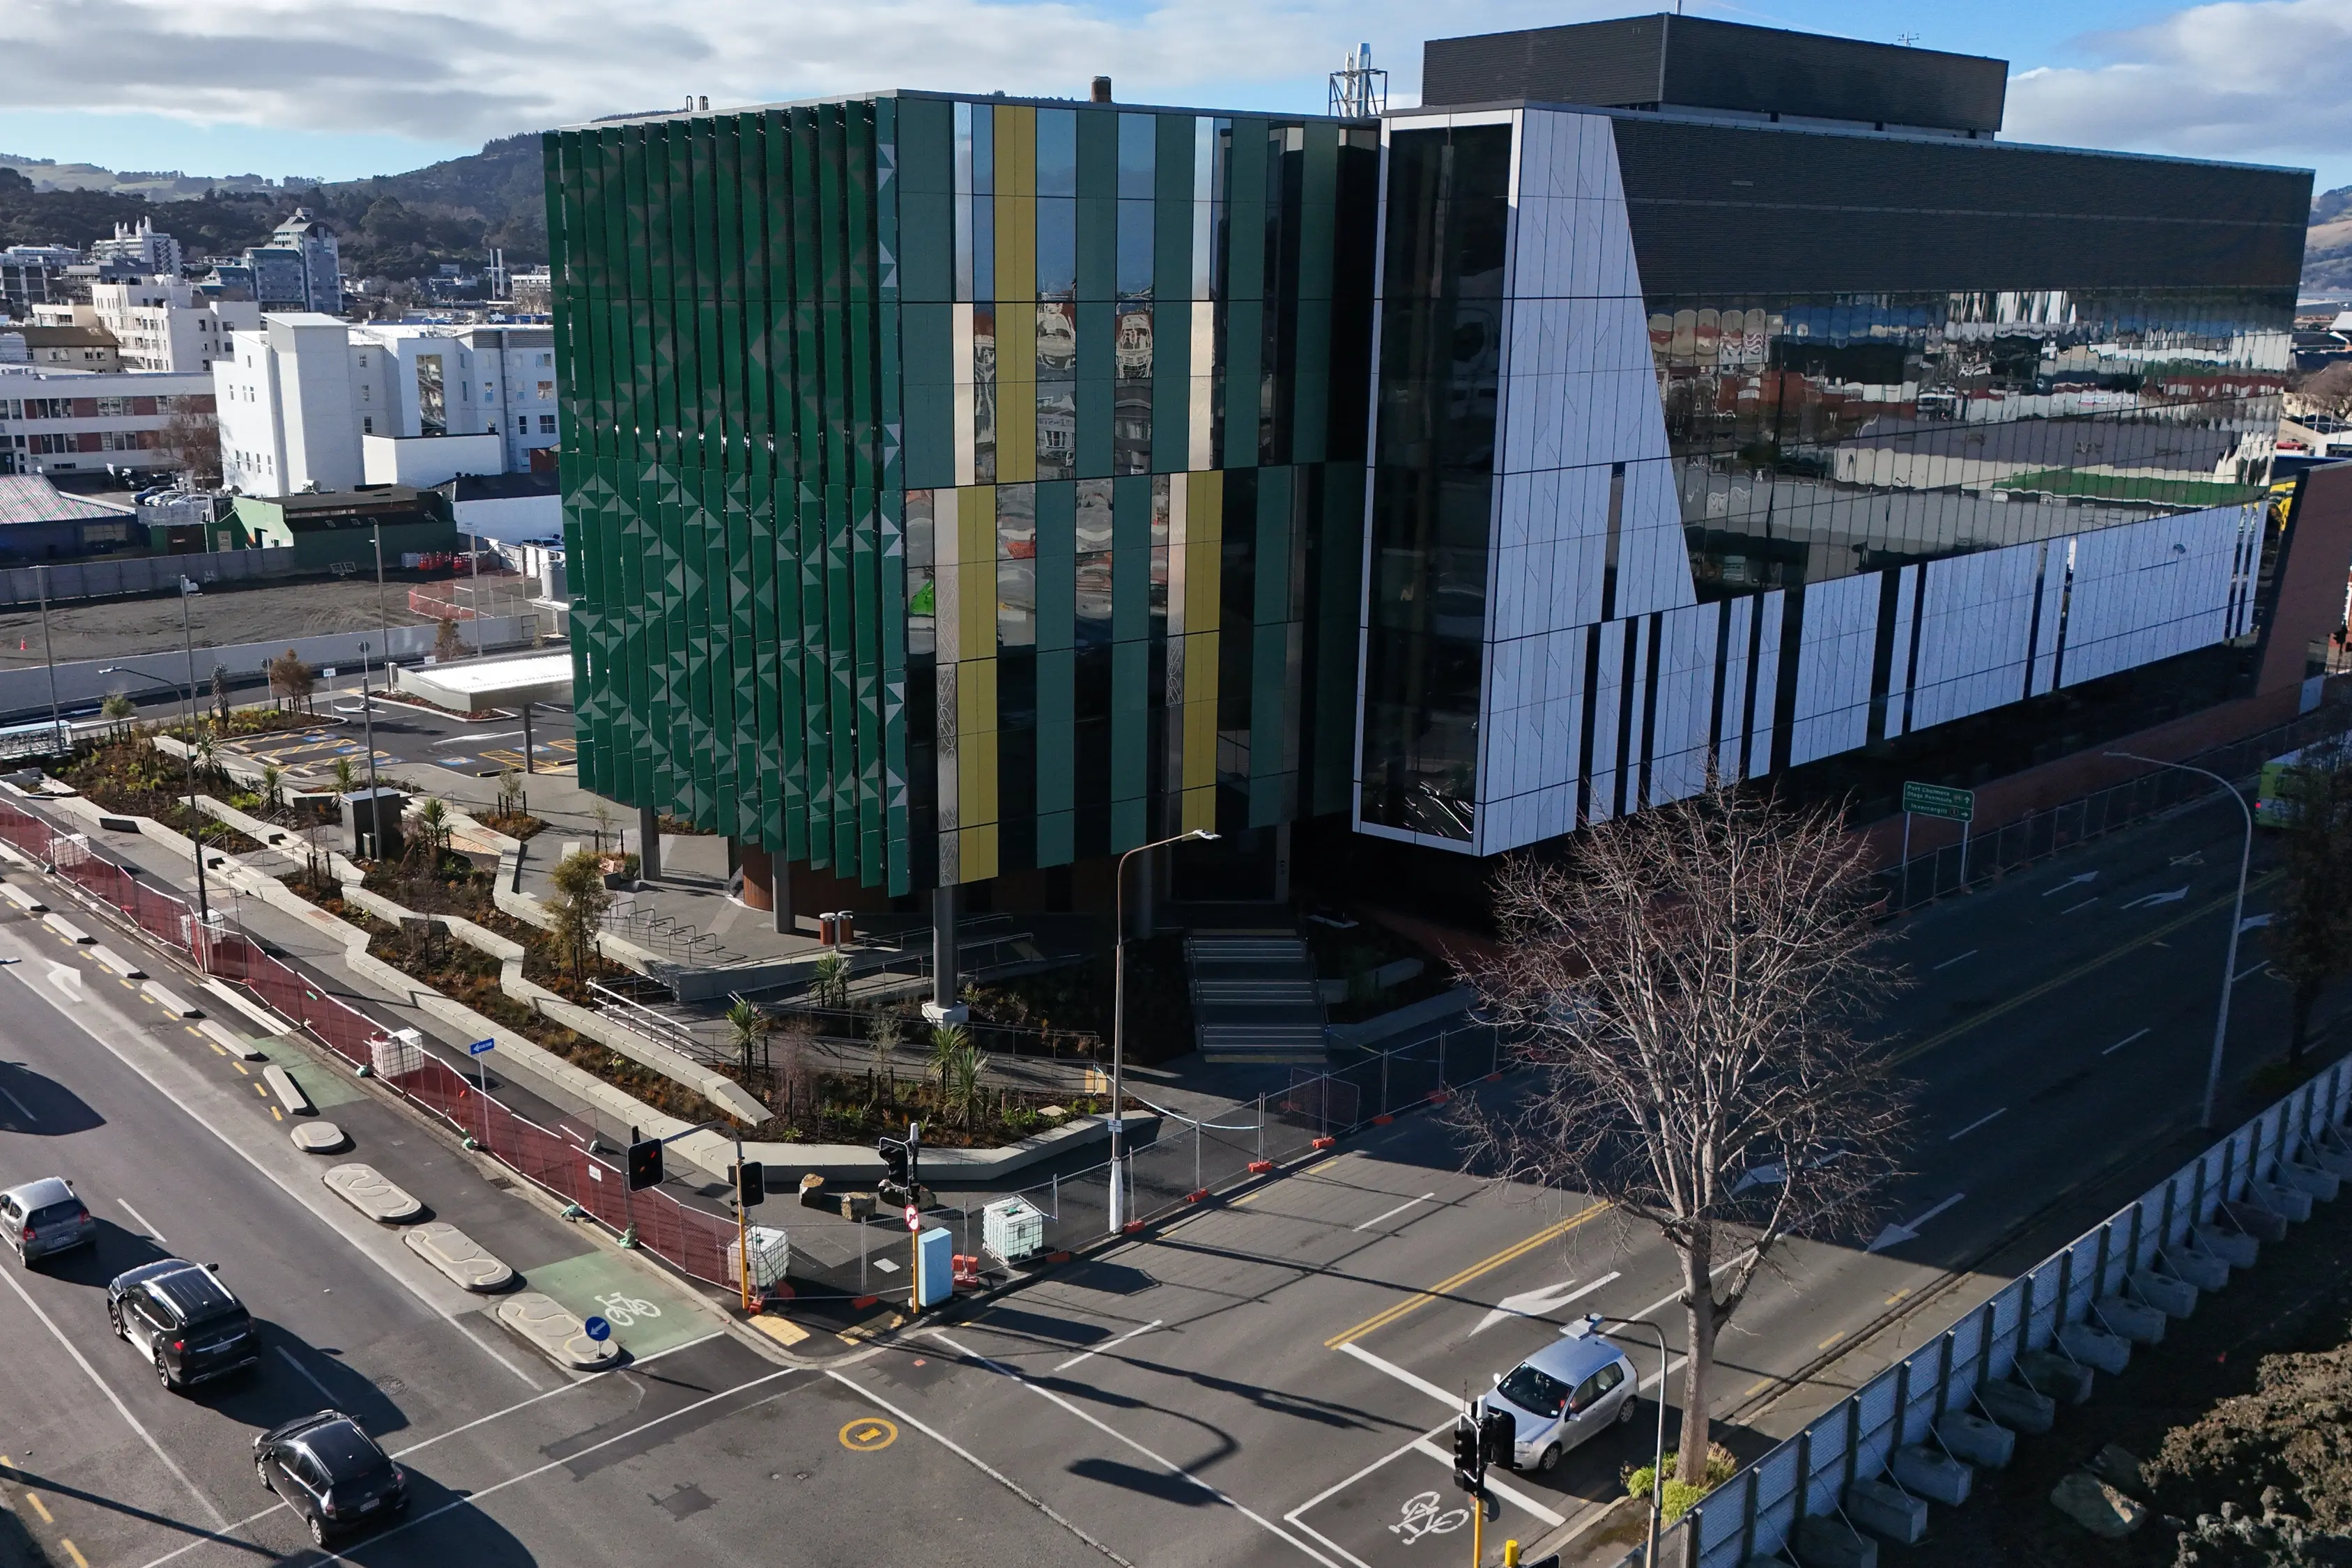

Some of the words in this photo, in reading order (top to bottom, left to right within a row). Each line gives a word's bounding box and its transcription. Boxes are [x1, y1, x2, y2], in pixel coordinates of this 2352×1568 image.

[1922, 787, 1950, 797] Chalmers
[1925, 794, 1952, 803] Peninsula
[1910, 803, 1948, 814] Invercargill
